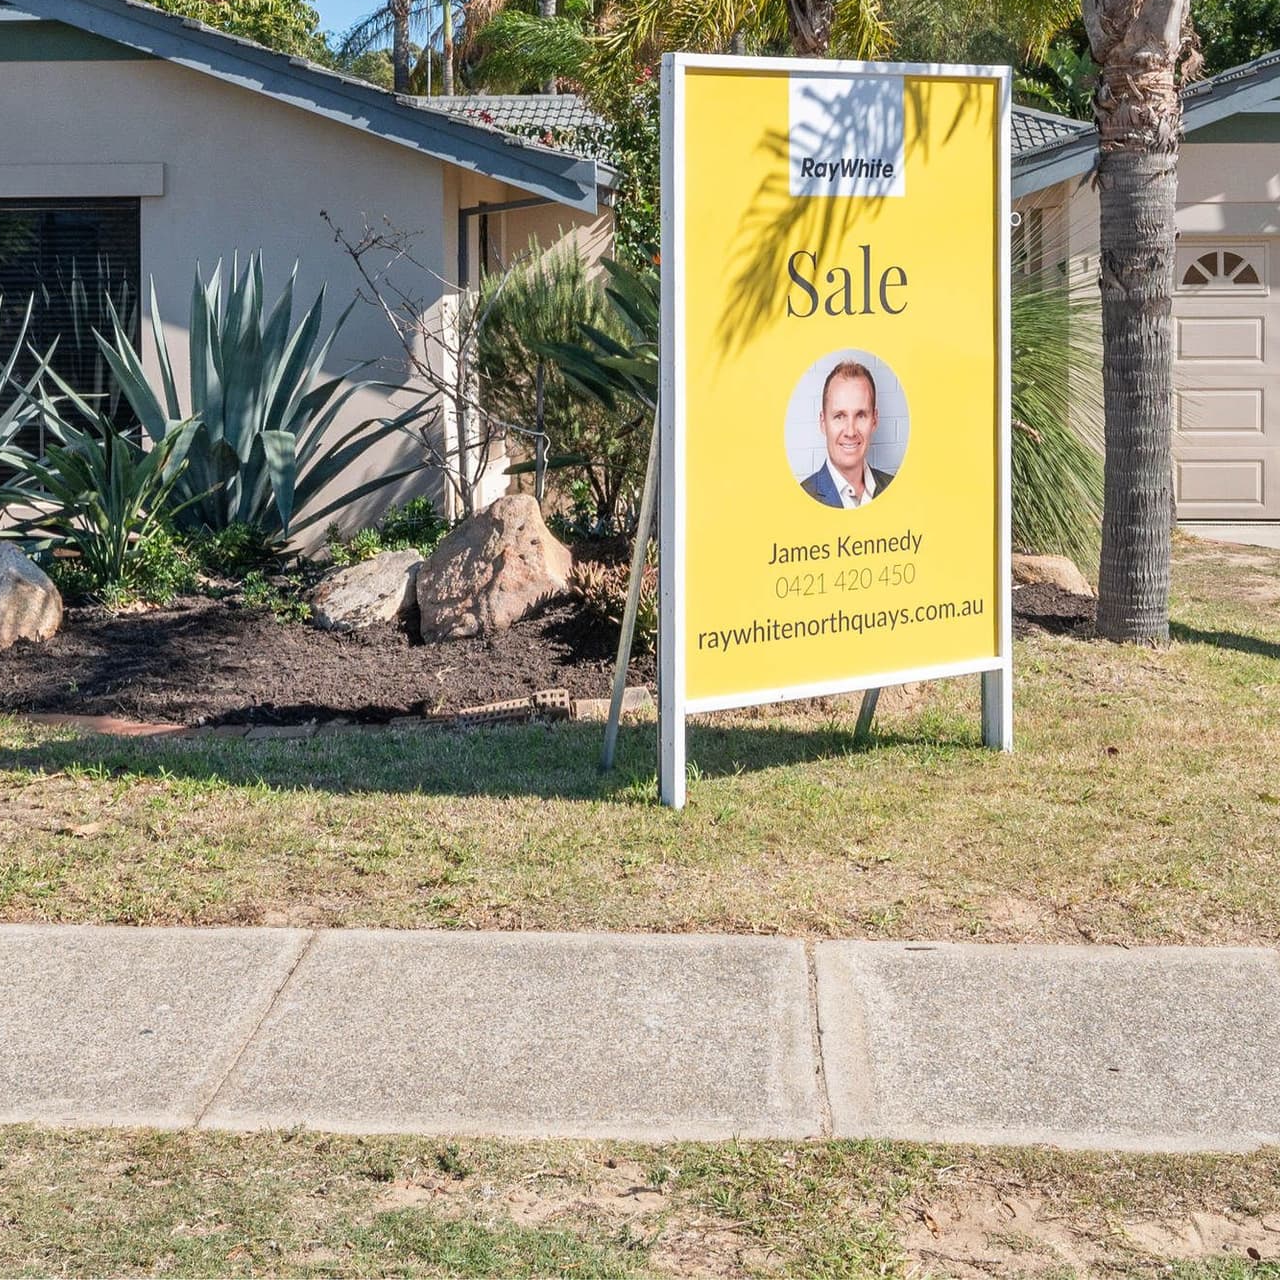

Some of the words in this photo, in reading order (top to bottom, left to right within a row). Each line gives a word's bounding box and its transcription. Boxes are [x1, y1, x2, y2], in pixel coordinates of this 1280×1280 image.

[787, 245, 908, 318] Sale
[768, 543, 830, 565] James
[837, 530, 923, 558] Kennedy
[775, 573, 827, 599] 0421
[834, 567, 872, 592] 420
[878, 563, 916, 586] 450
[698, 598, 984, 652] raywhitenorthquays.com.au
